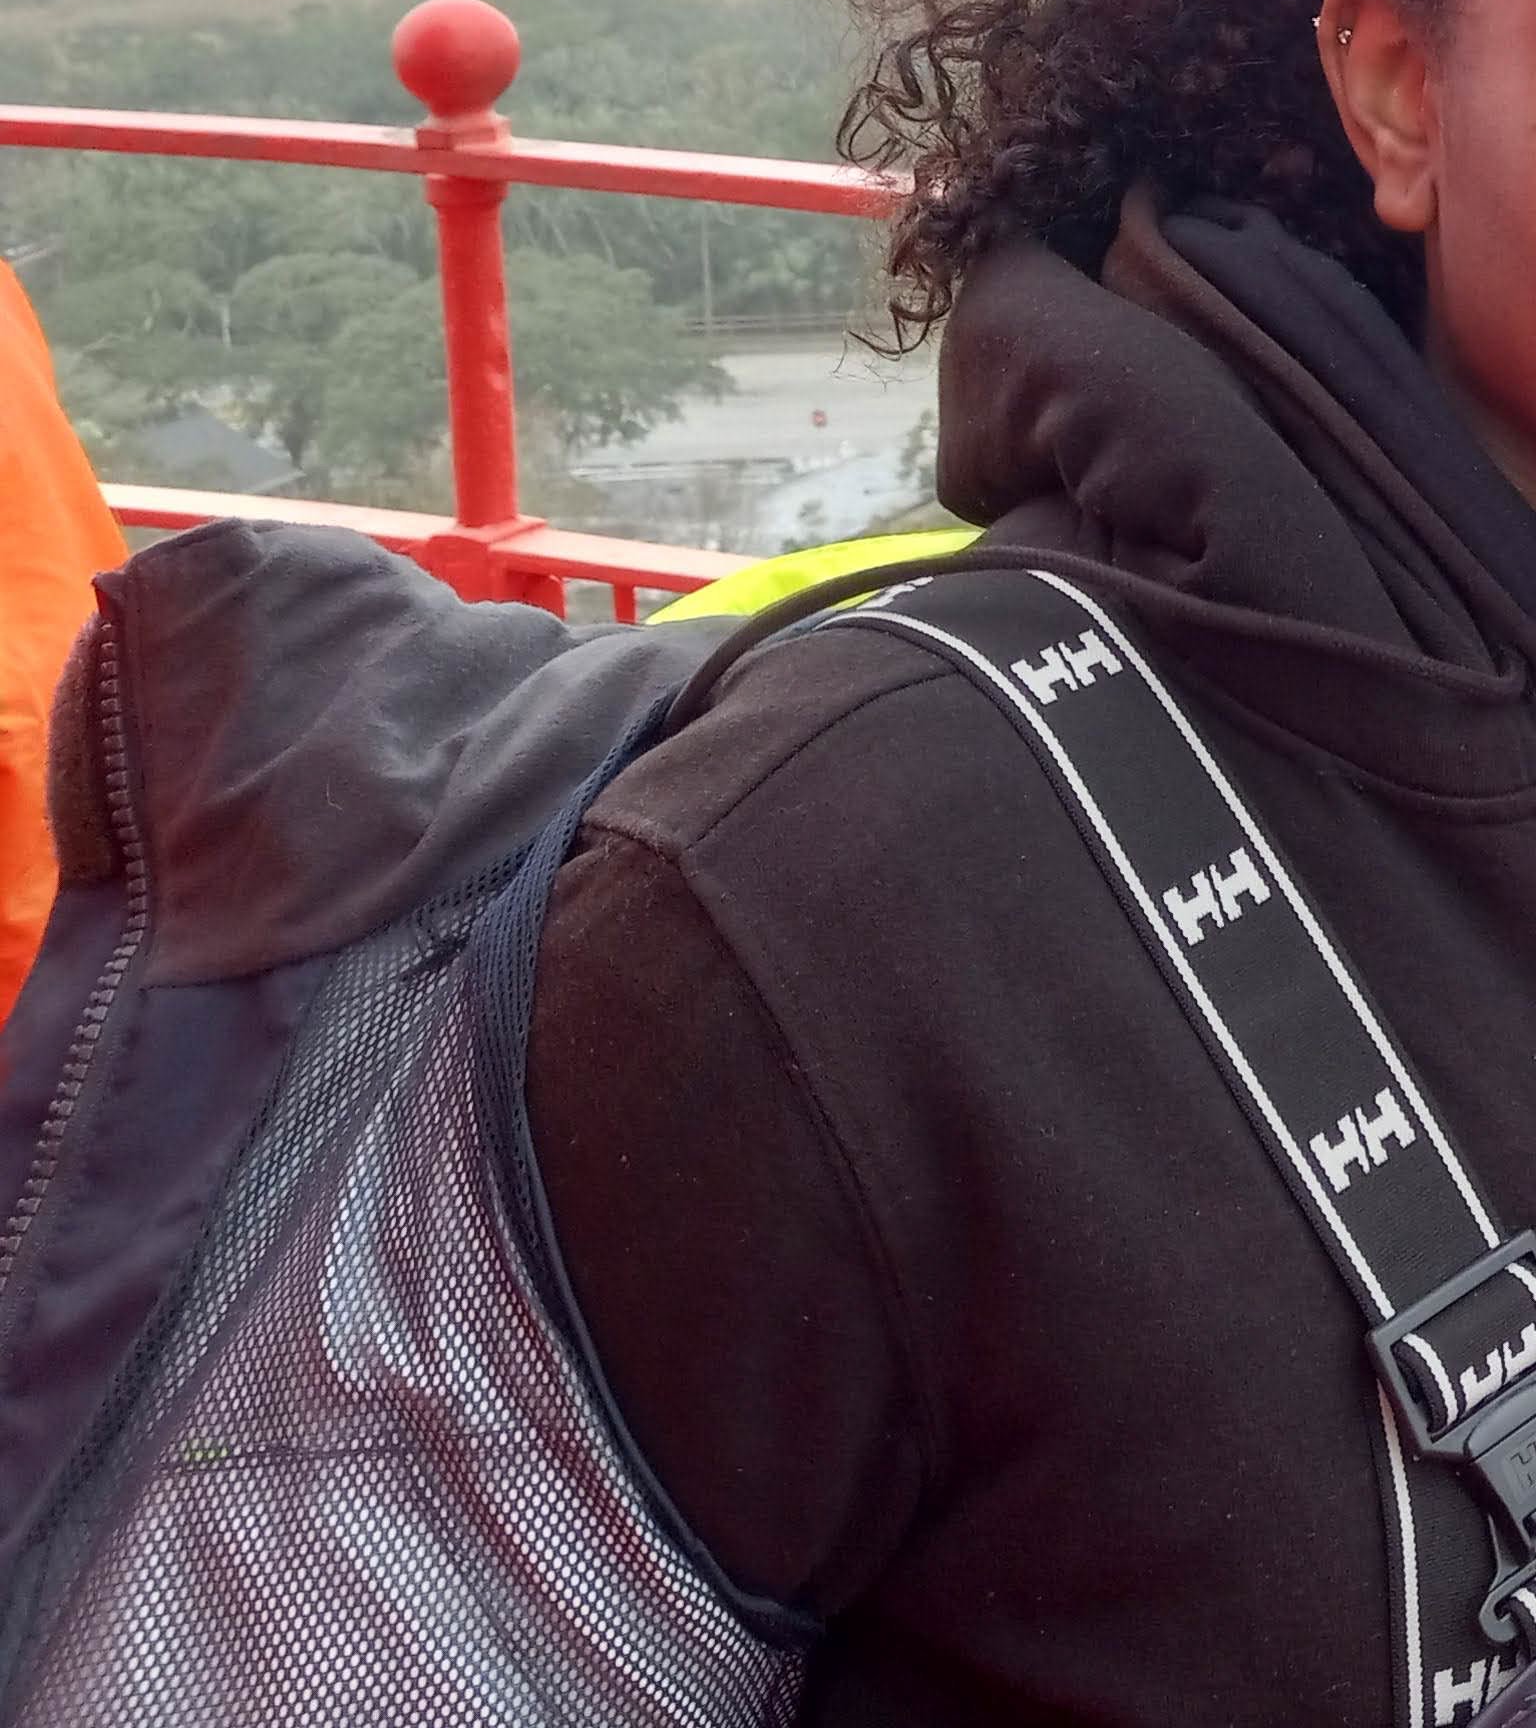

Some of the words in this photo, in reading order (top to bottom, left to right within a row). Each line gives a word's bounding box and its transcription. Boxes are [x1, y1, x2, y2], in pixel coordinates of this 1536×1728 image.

[1011, 629, 1122, 704] HH
[1163, 847, 1270, 945] HH
[1310, 1088, 1416, 1193] HH
